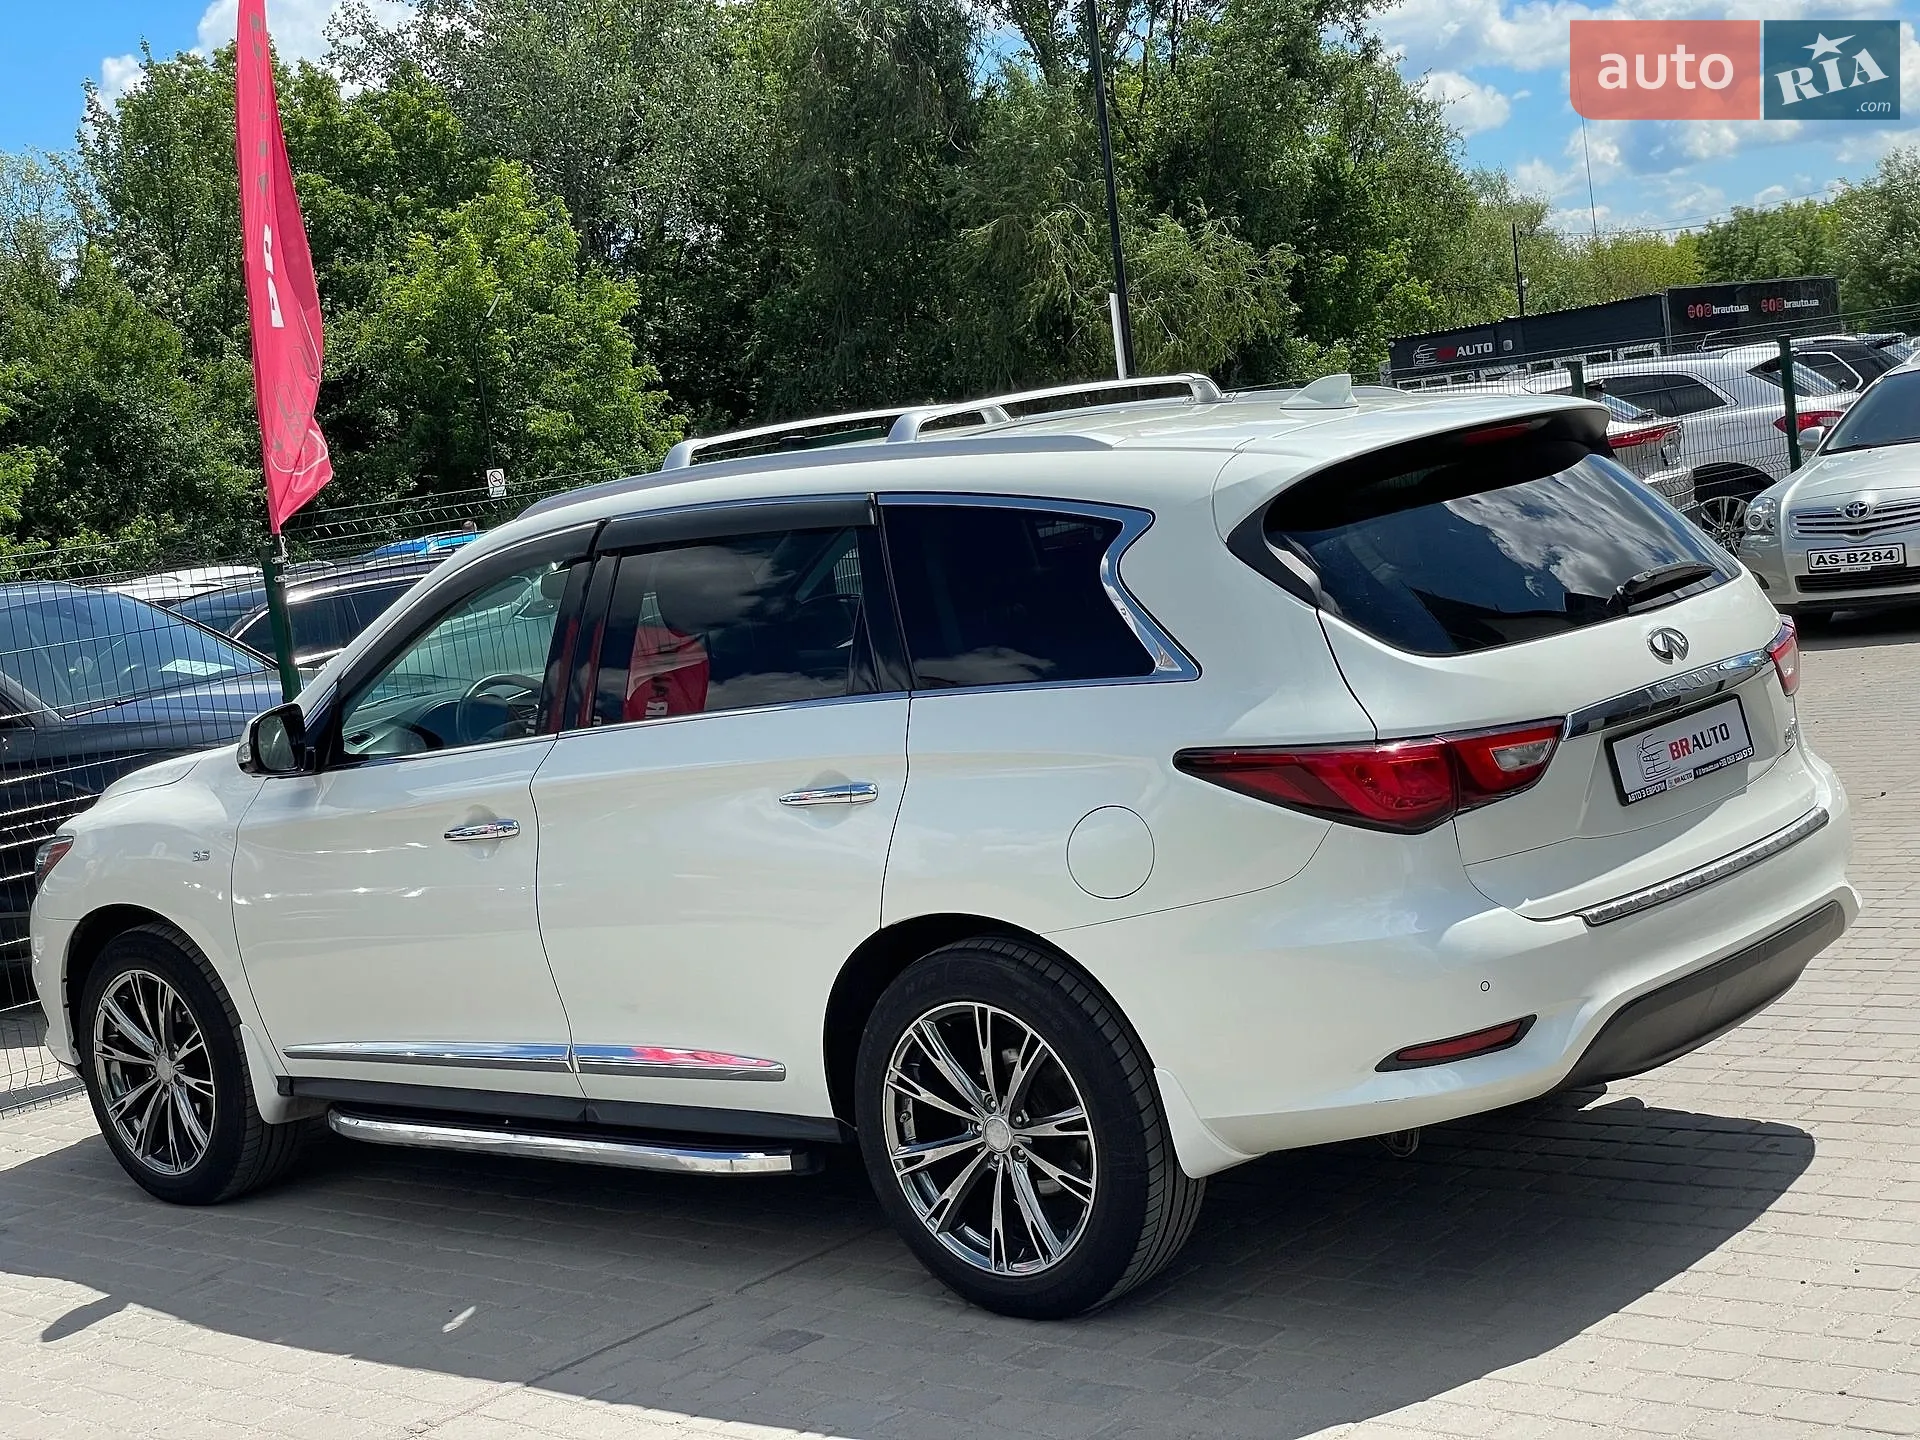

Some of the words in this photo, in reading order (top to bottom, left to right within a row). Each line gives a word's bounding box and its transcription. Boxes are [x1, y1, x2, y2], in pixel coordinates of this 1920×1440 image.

[1712, 304, 1749, 315] brauto.ua
[1784, 299, 1819, 308] brauto.ua
[1815, 550, 1895, 566] AS-B284
[1668, 722, 1731, 761] BRAUTO
